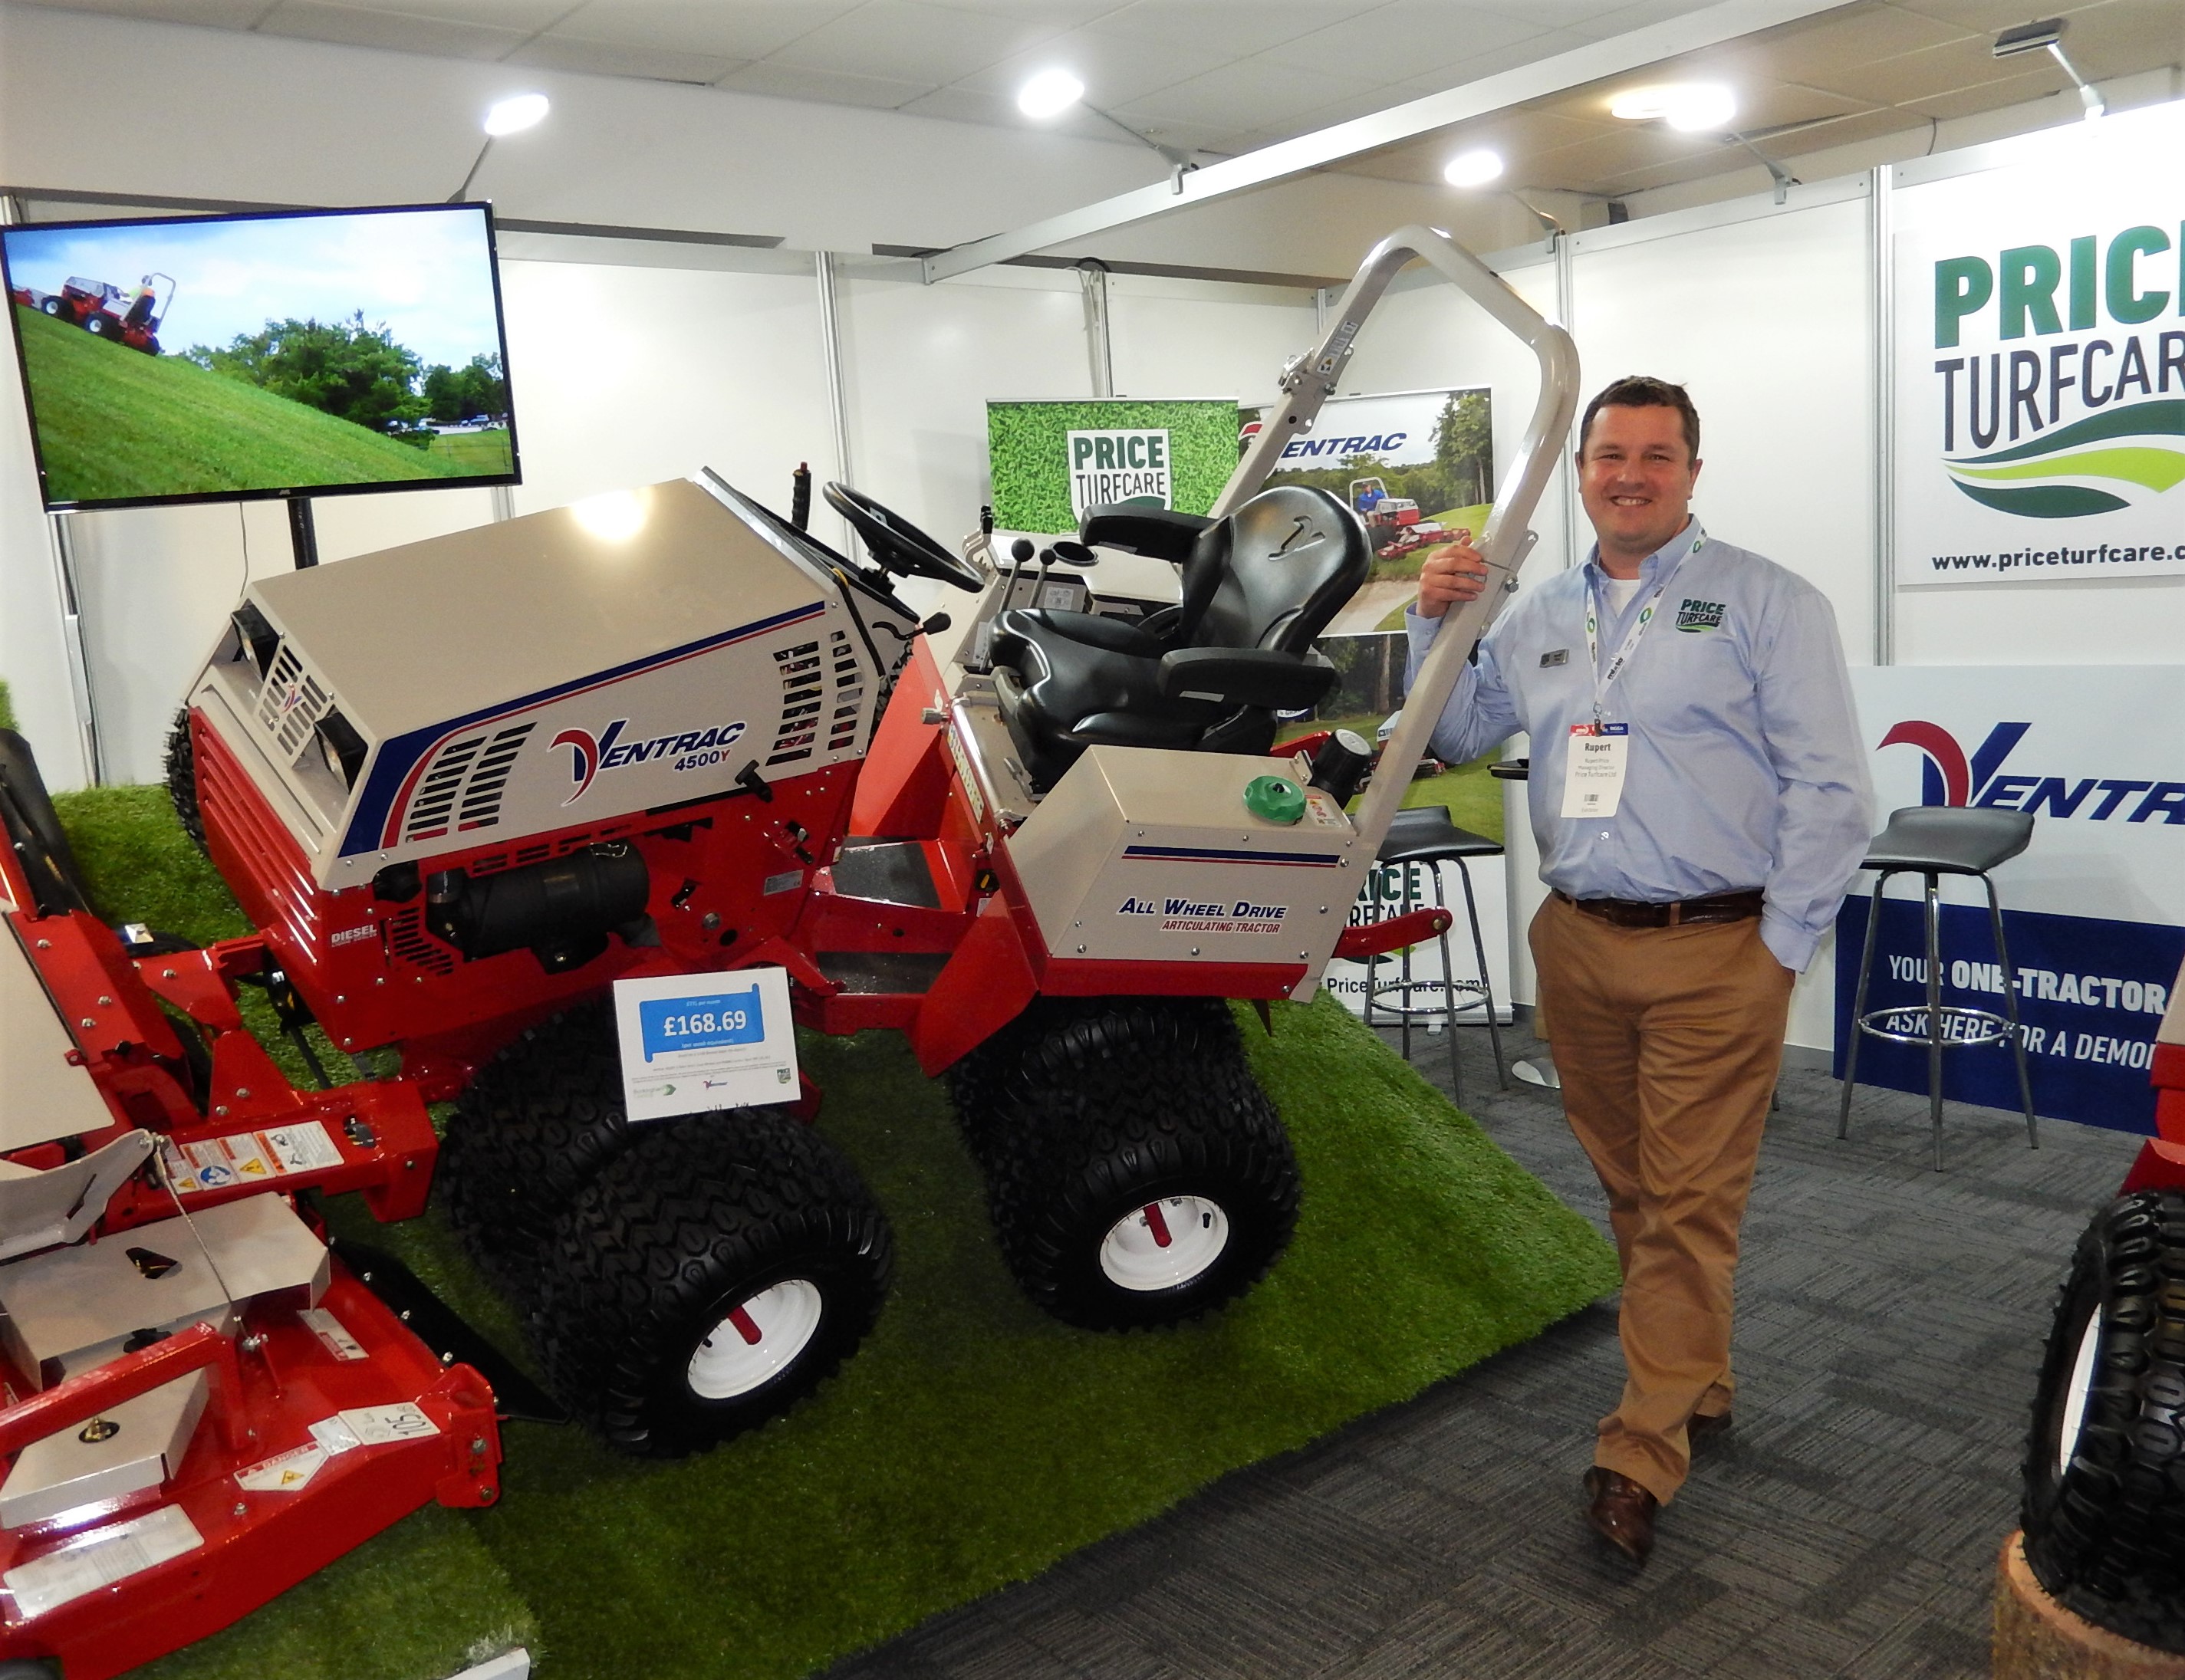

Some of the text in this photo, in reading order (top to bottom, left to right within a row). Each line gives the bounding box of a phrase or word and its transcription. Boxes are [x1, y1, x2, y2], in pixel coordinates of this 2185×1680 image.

[1934, 220, 2185, 350] PRIC
[1074, 436, 1164, 470] PRICE
[1280, 432, 1407, 459] ENTRAC
[1075, 472, 1166, 509] TURFCARE
[1676, 611, 1723, 626] TURFCARE
[1680, 599, 1726, 615] PRICE
[674, 749, 731, 771] 4500Y
[1584, 742, 1611, 754] Rupert
[549, 719, 745, 805] VENTRAC
[1119, 897, 1287, 919] ALL WHEEL DRIVE
[331, 924, 377, 944] DIESEL
[1162, 921, 1281, 933] ARTICULATING TRACTOR
[1951, 960, 2166, 1015] ONE-TRACTOR
[663, 1010, 746, 1037] £168.69
[1885, 1014, 1929, 1036] ASK
[1940, 1014, 1995, 1040] HERE
[1999, 1024, 2046, 1054] OR
[2049, 1031, 2066, 1057] A
